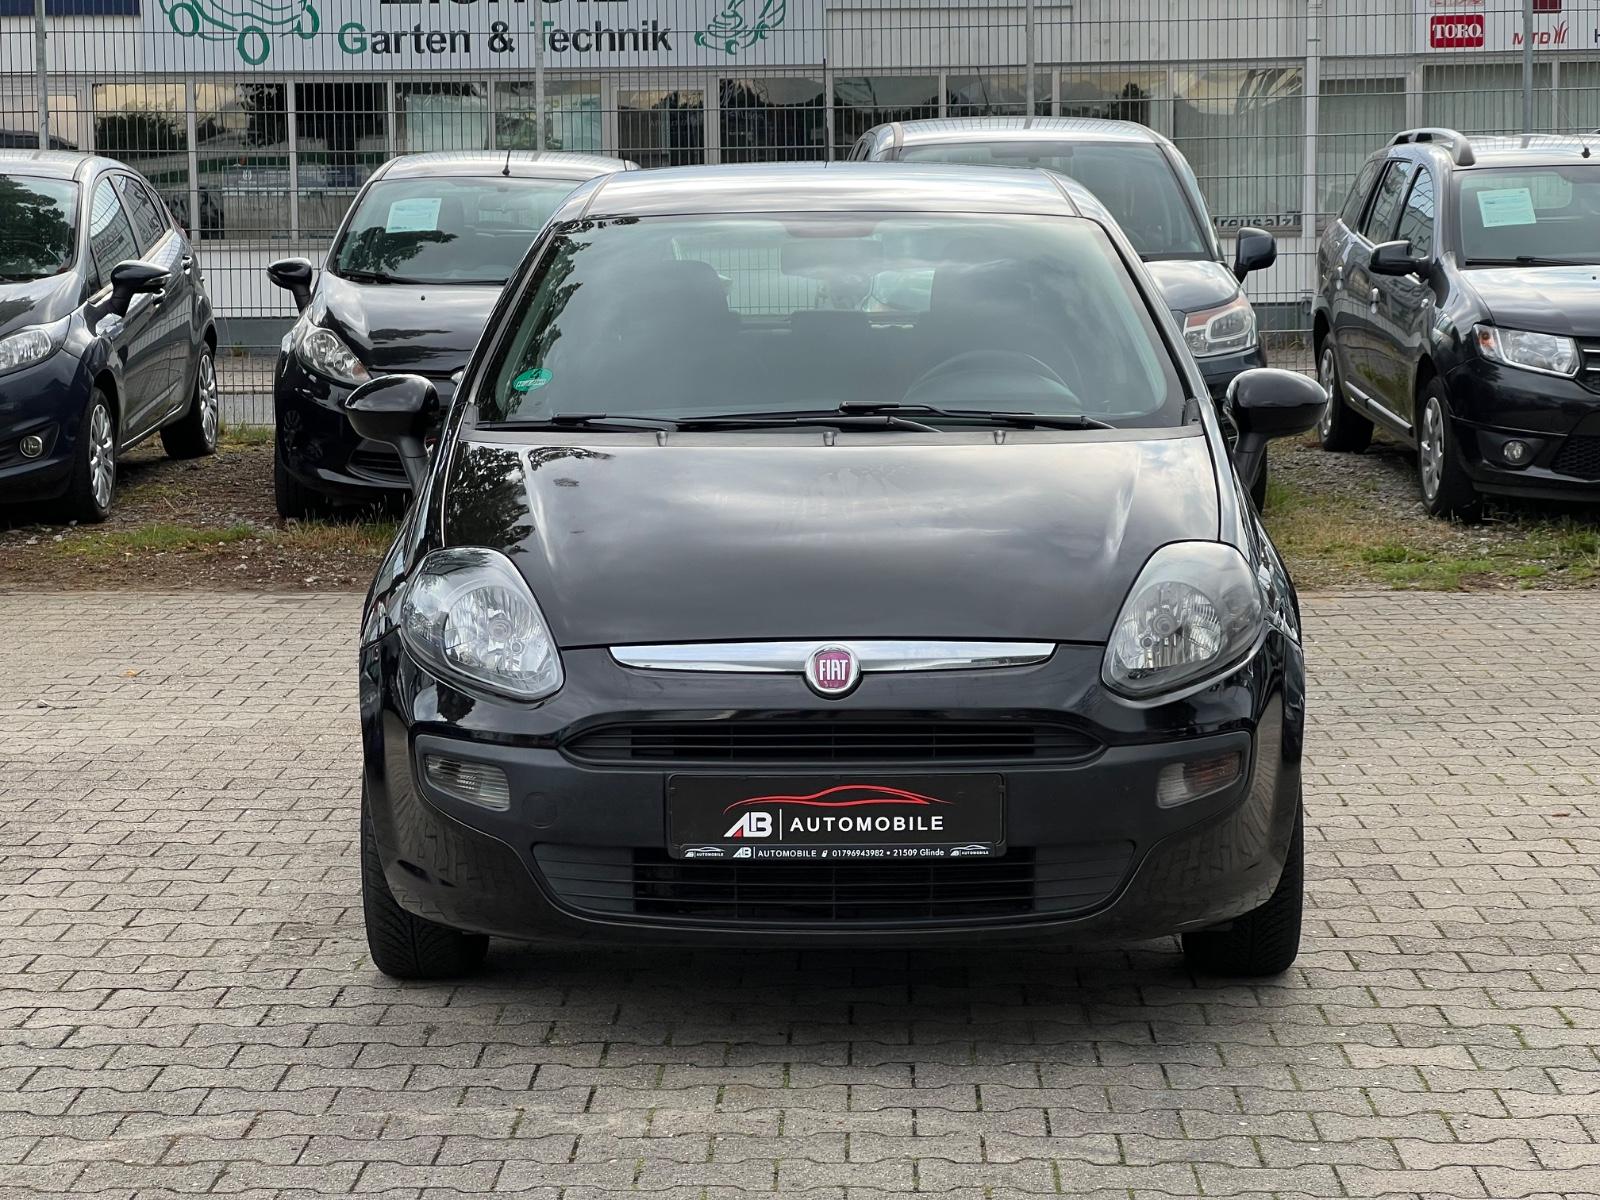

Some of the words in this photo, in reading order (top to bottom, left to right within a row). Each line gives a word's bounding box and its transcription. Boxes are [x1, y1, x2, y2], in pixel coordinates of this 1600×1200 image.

[338, 21, 471, 54] Garten
[488, 20, 515, 54] &
[530, 19, 672, 52] Technik
[1433, 23, 1482, 39] TORO
[819, 659, 848, 681] FIAT
[723, 811, 773, 838] AB
[789, 815, 944, 832] AUTOMOBILE
[732, 846, 752, 858] AB
[757, 849, 817, 858] AUTOMOBILE
[832, 849, 884, 857] 01796943982
[893, 848, 918, 857] 21509
[920, 848, 945, 857] Glinde
